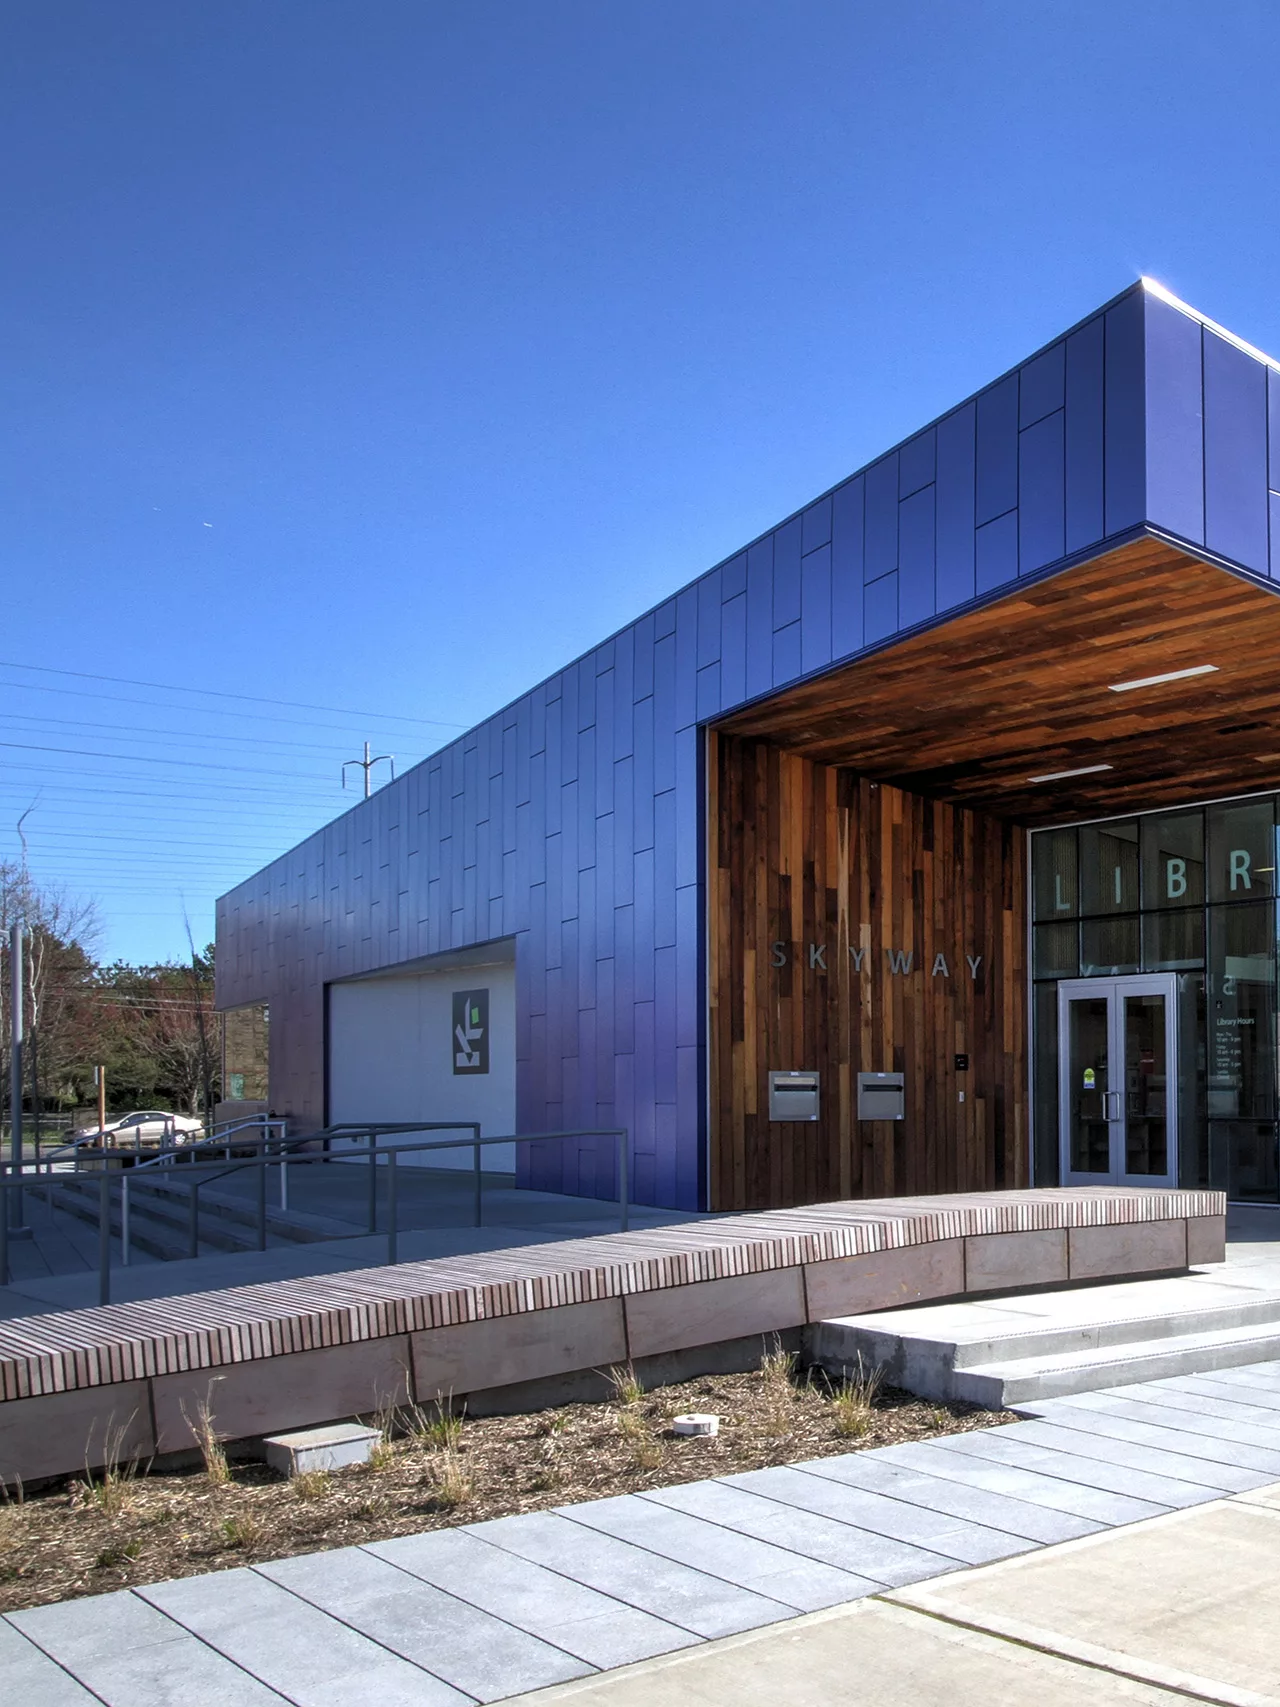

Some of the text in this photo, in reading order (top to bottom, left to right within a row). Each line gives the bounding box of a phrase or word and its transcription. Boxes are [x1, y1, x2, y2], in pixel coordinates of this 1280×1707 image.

[771, 940, 982, 980] SKYWAY
[1217, 1017, 1254, 1026] Library Hours
